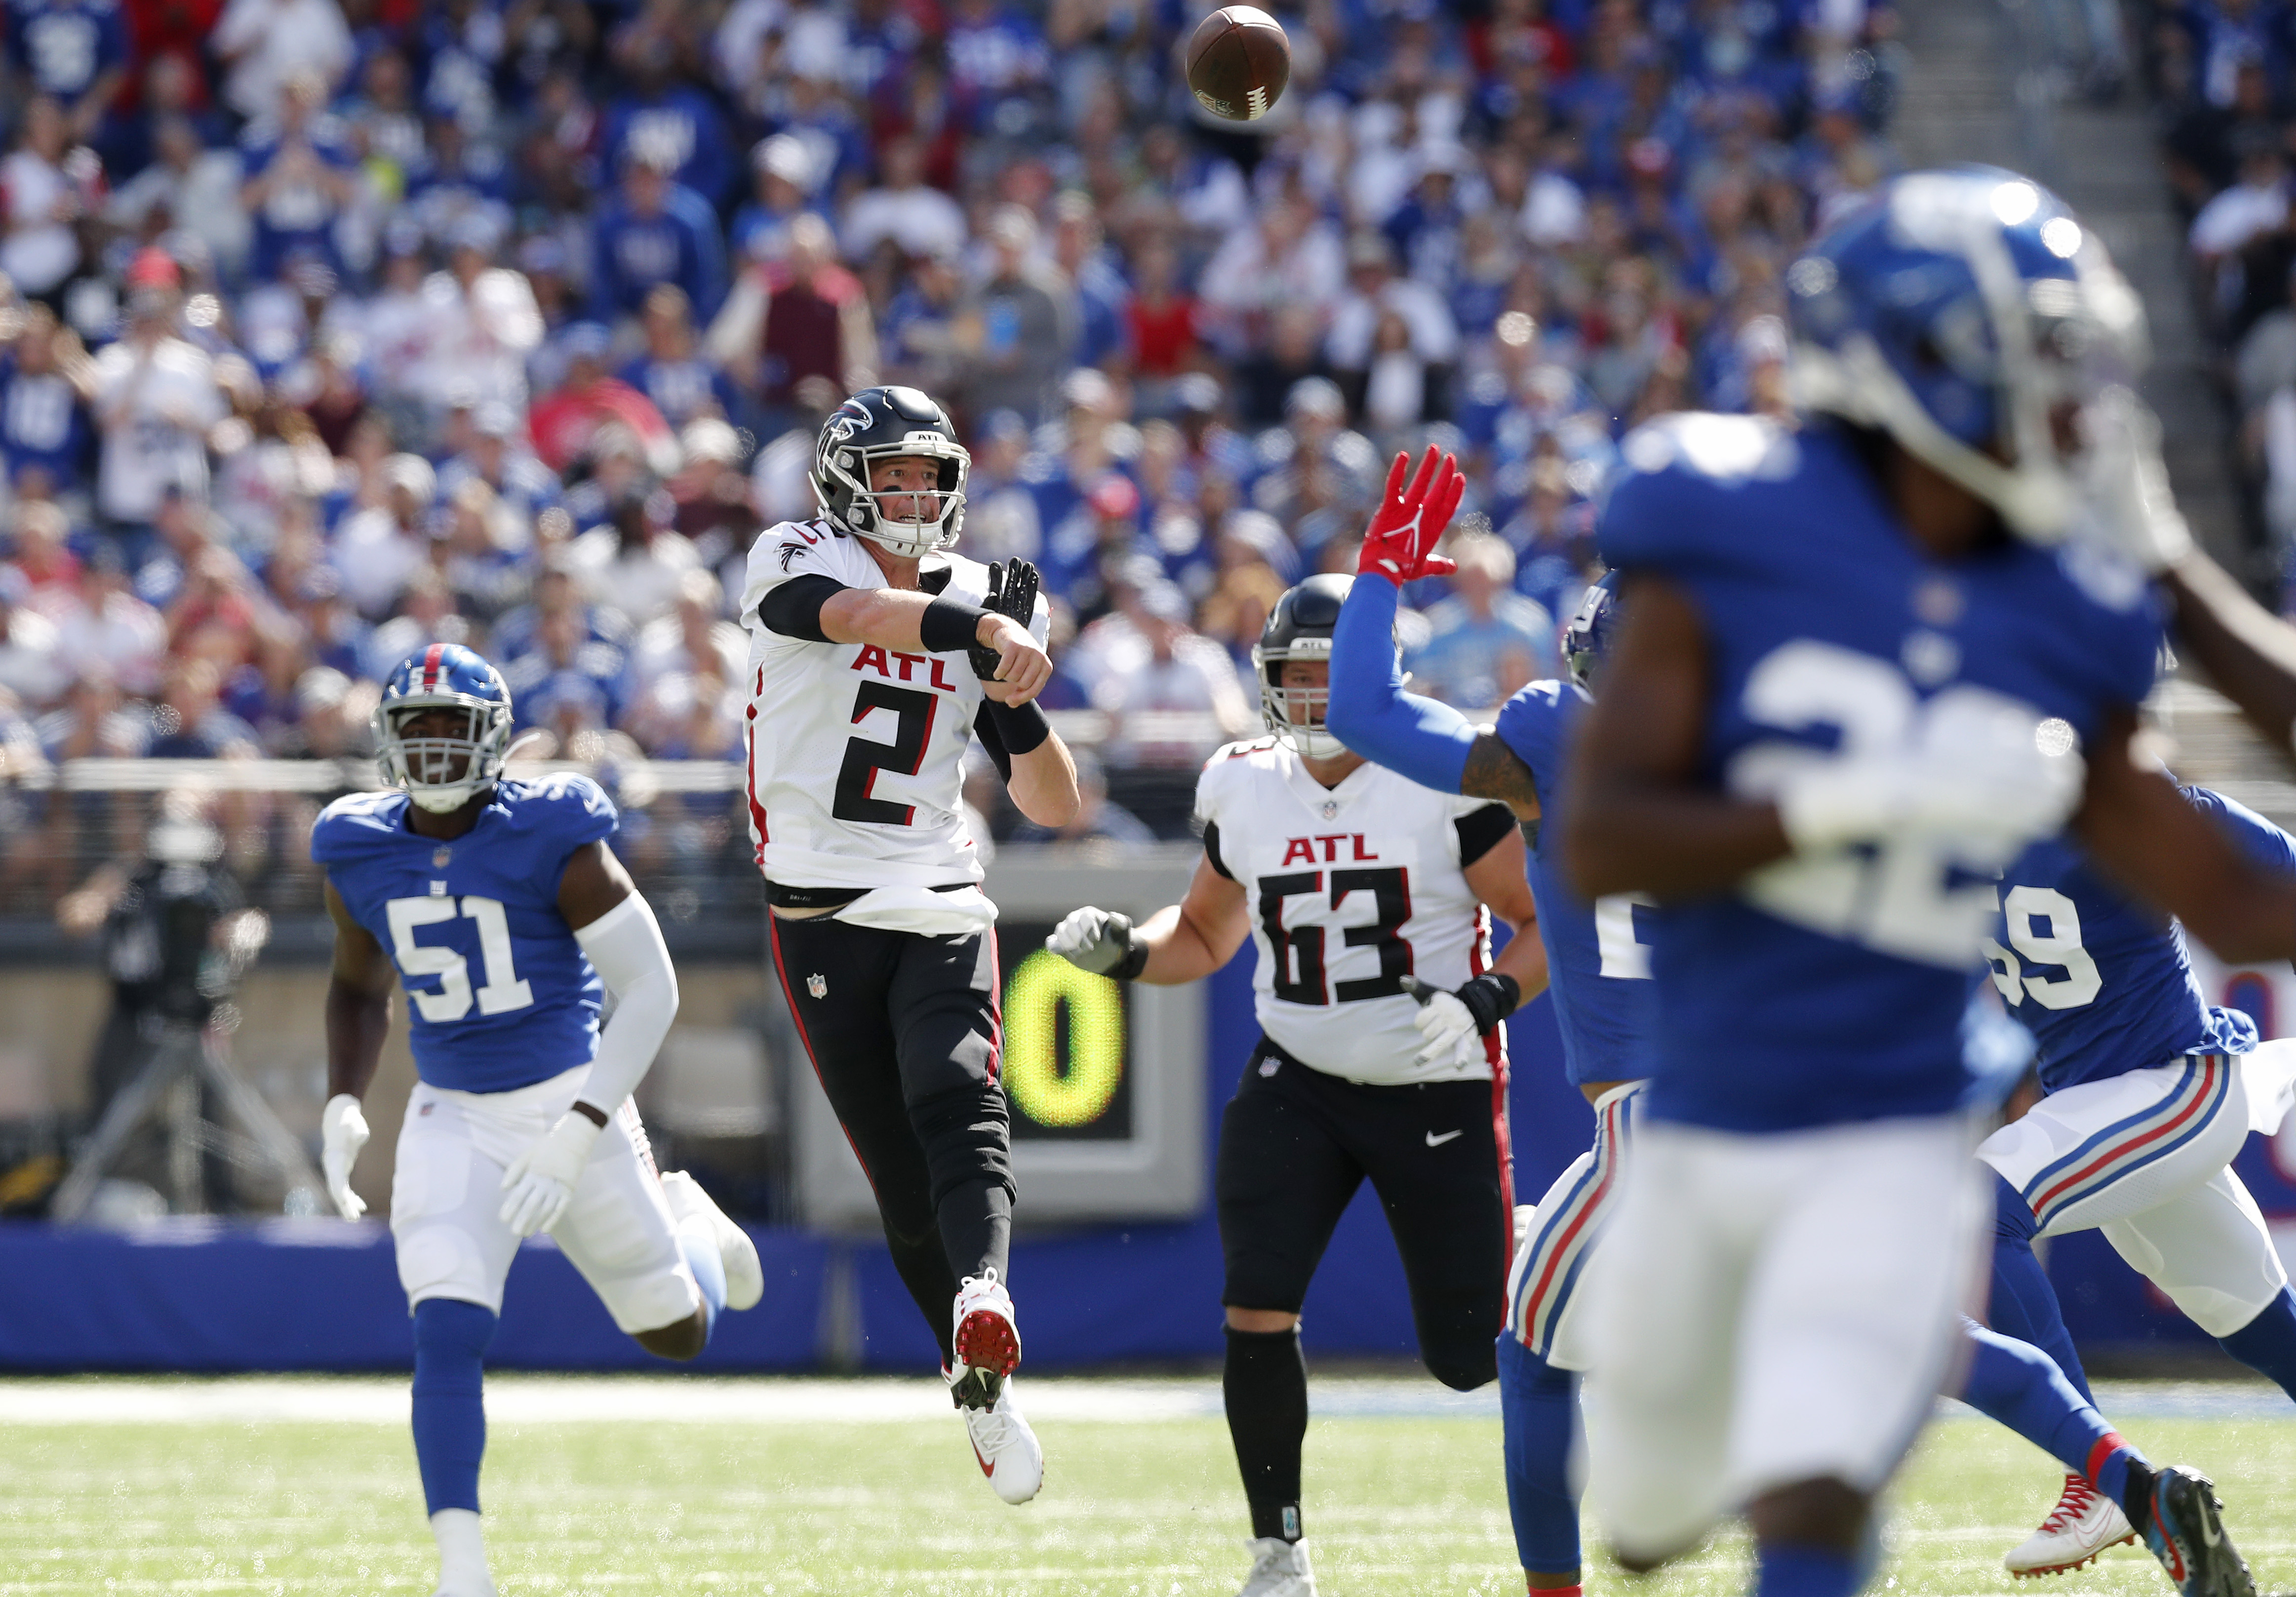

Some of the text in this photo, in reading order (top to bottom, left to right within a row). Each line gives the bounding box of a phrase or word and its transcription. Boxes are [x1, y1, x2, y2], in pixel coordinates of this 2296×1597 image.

[408, 665, 448, 686] 51
[850, 643, 956, 692] ATL
[832, 680, 939, 826] 2
[1282, 834, 1379, 866] ATL
[386, 895, 534, 1023] 51
[1258, 867, 1414, 1005] 63
